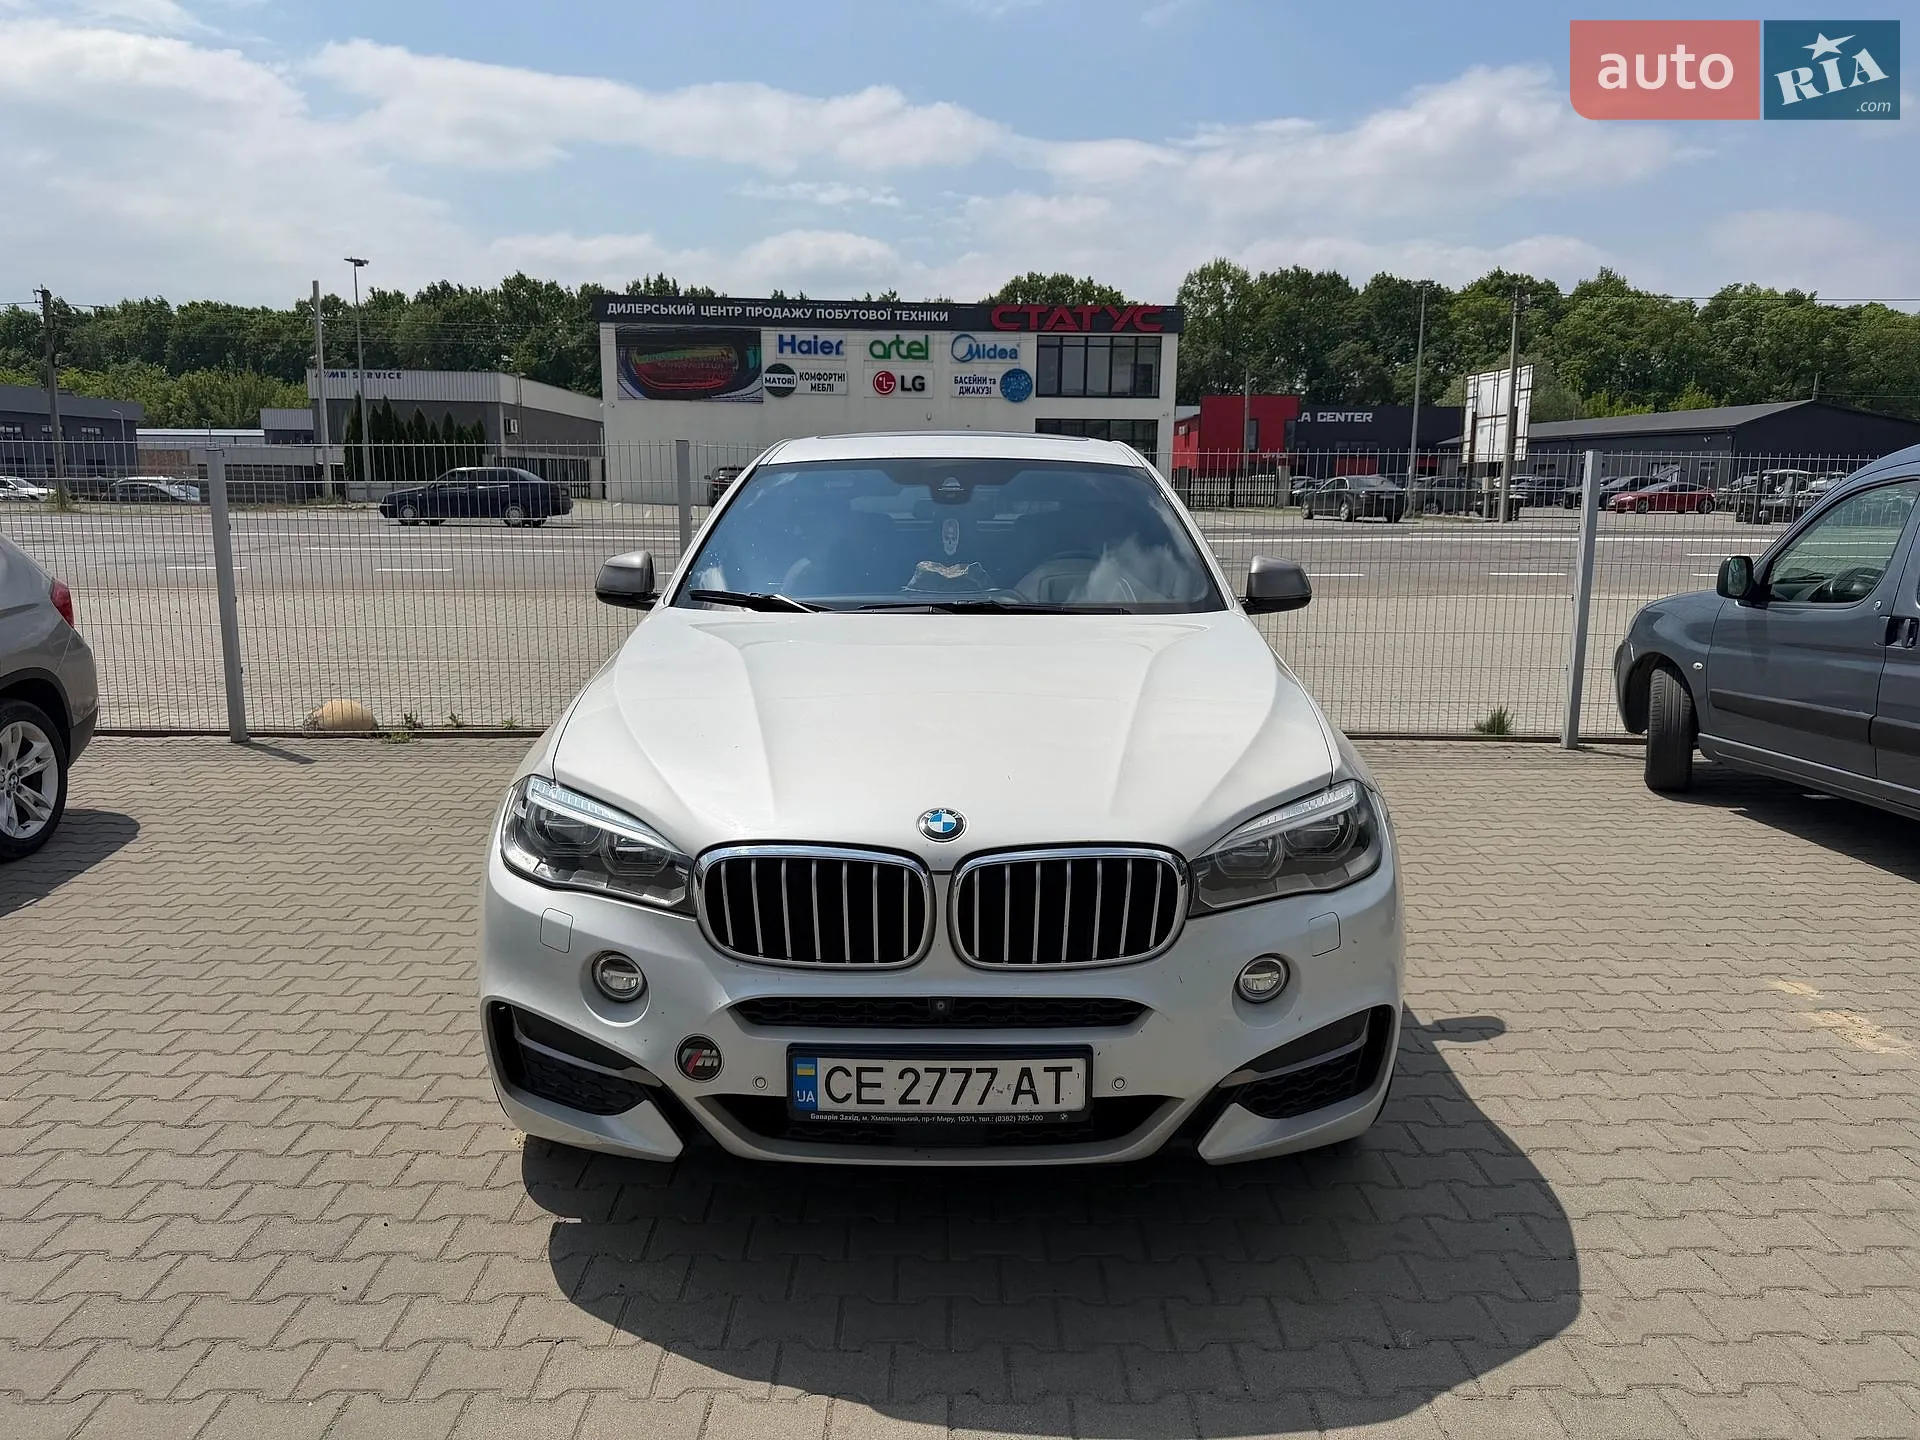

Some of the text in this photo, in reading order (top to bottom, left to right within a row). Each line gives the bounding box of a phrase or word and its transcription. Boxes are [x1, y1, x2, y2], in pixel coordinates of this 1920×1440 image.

[607, 302, 949, 322] ДИЛЕРСЬКИЙ ЦЕНТР ПРОДАЖУ ПОБУТОВОЇ ТЕХНІКИ
[990, 304, 1163, 332] СТАТУС
[778, 334, 844, 356] Haier
[868, 334, 929, 360] artel
[951, 333, 1018, 363] Midea
[799, 371, 846, 382] КОМФОРТНІ
[900, 375, 925, 392] LG
[954, 374, 987, 385] БАСЕЙНИ
[810, 382, 834, 392] МЕБЛІ
[958, 386, 992, 396] ДЖАКУЗІ
[1317, 412, 1373, 423] CENTER
[824, 1066, 1073, 1106] CE 2777 AT
[796, 1090, 816, 1103] UA
